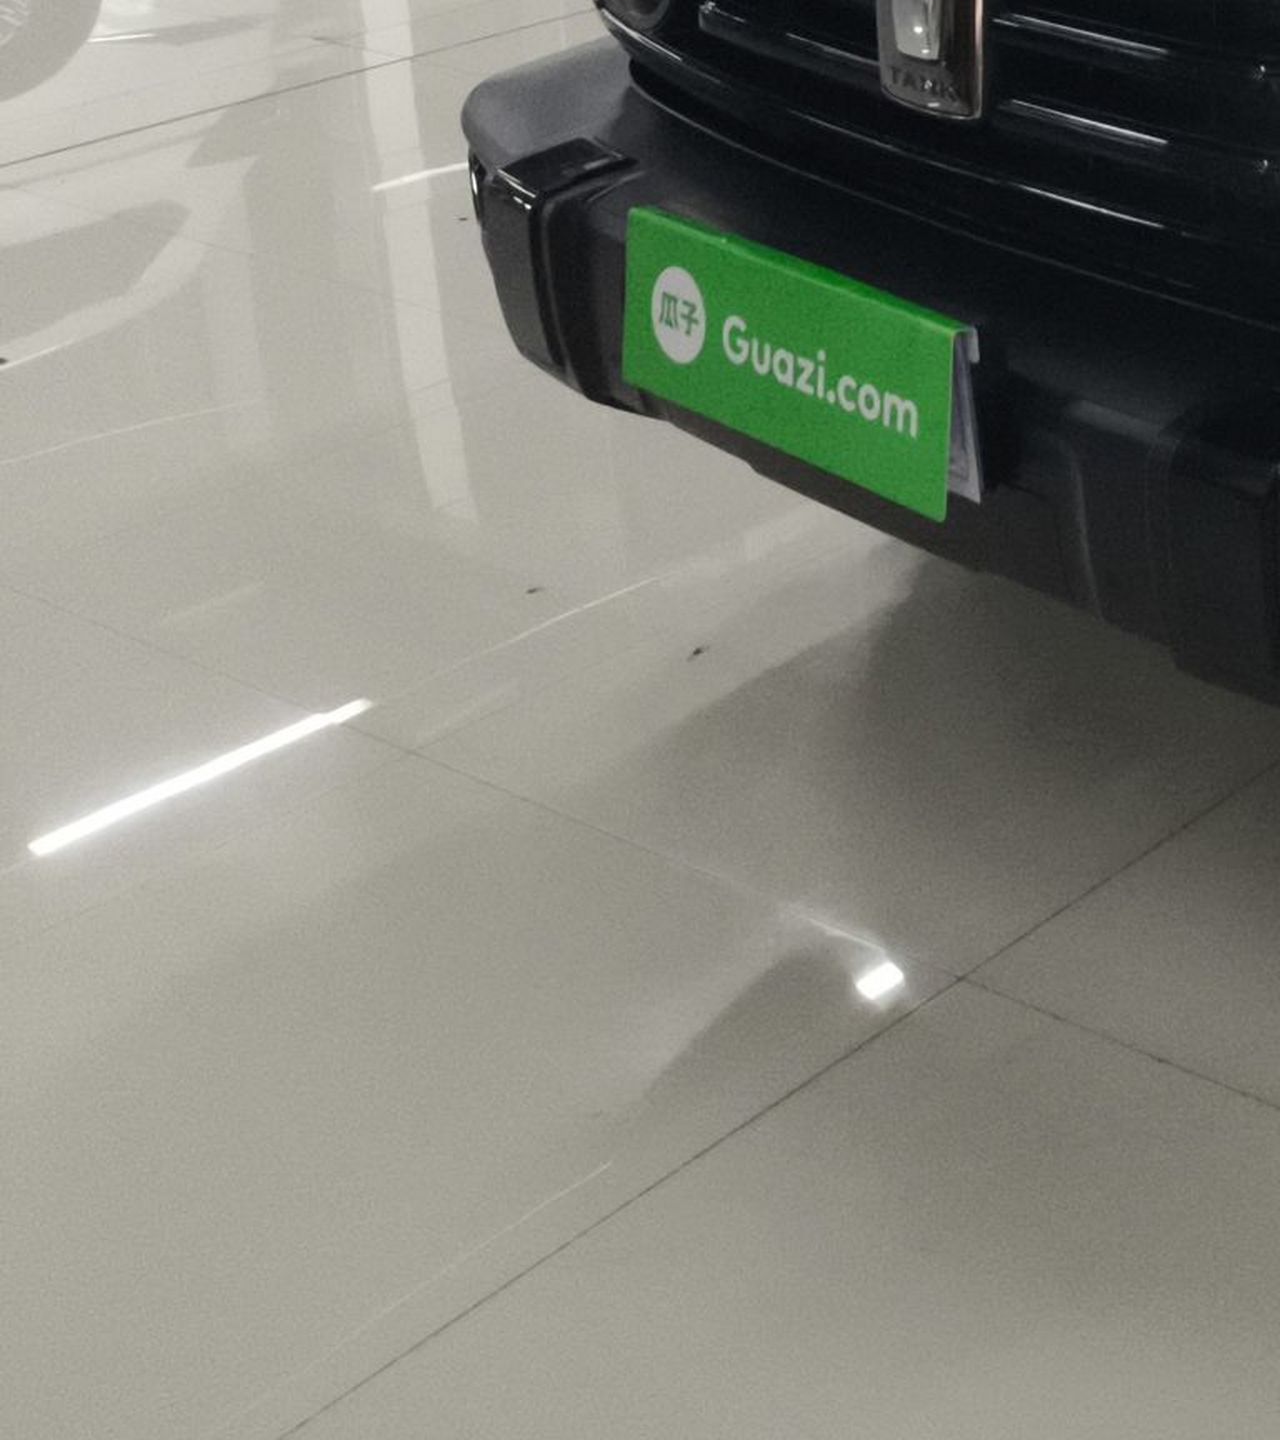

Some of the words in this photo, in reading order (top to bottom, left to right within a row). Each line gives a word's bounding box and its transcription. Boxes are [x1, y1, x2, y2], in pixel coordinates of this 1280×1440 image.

[889, 64, 962, 104] TANK
[658, 291, 699, 337] 瓜子
[722, 315, 919, 440] Guazi.com
